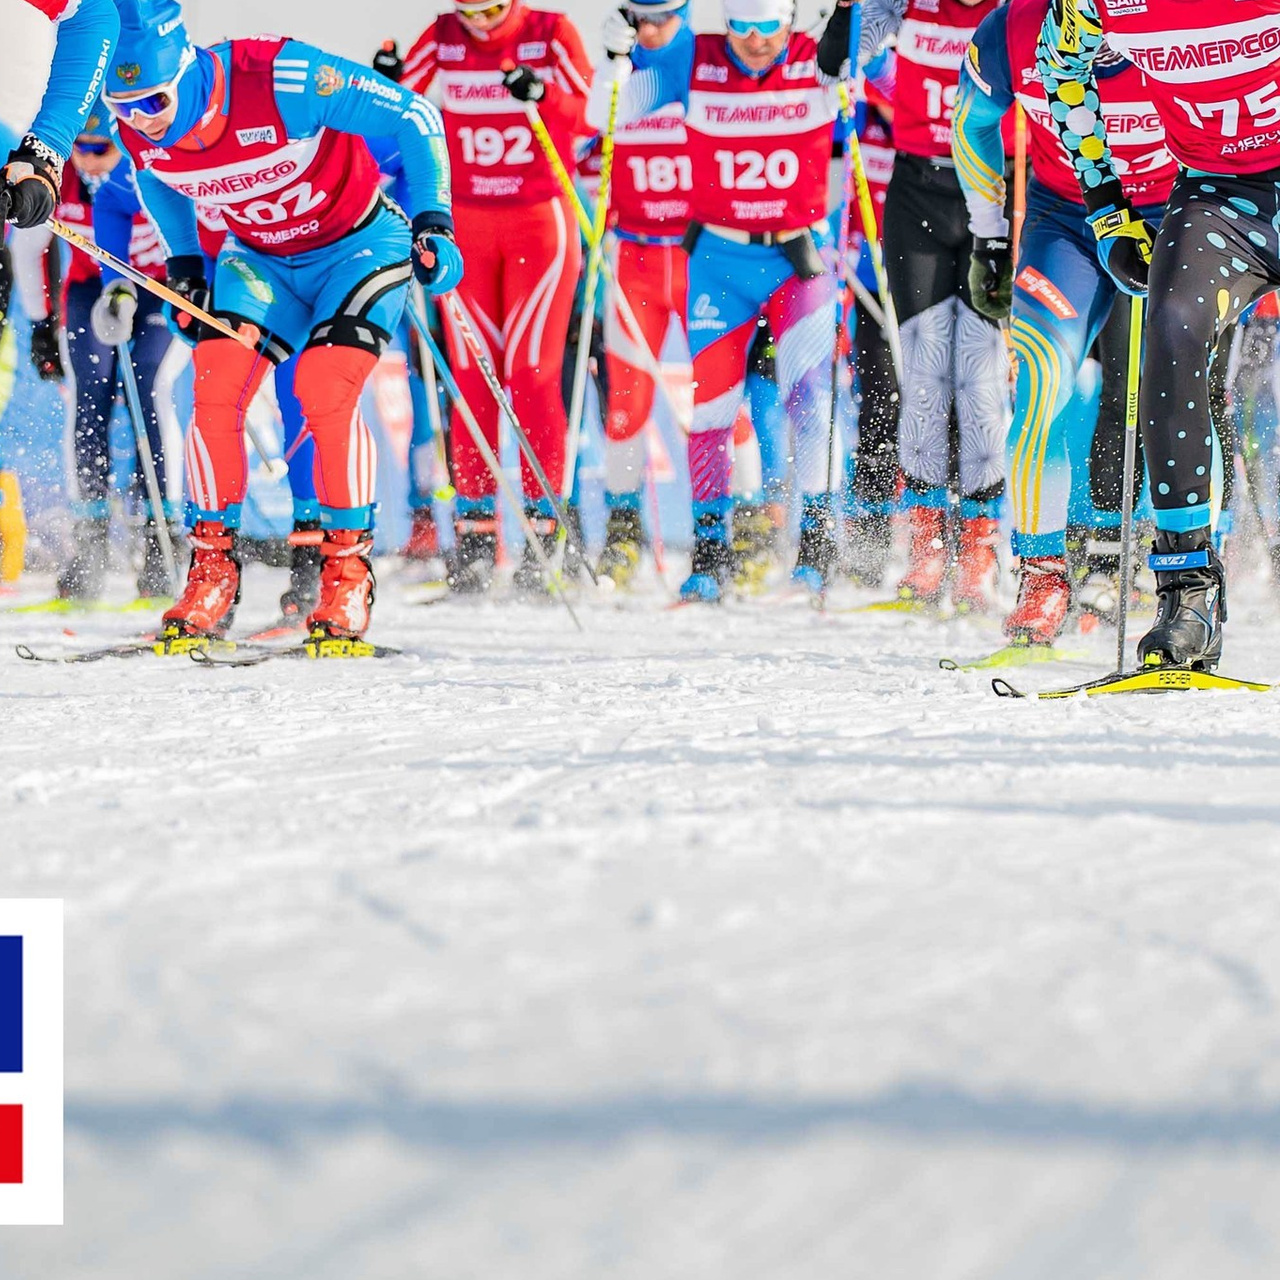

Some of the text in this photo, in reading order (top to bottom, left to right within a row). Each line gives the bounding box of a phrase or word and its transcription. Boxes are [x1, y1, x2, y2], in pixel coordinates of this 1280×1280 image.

[77, 38, 111, 116] NORDSKI
[922, 78, 960, 120] 19
[457, 125, 535, 166] 192
[627, 155, 693, 192] 181
[714, 149, 799, 190] 120
[1159, 673, 1191, 685] FISCHER
